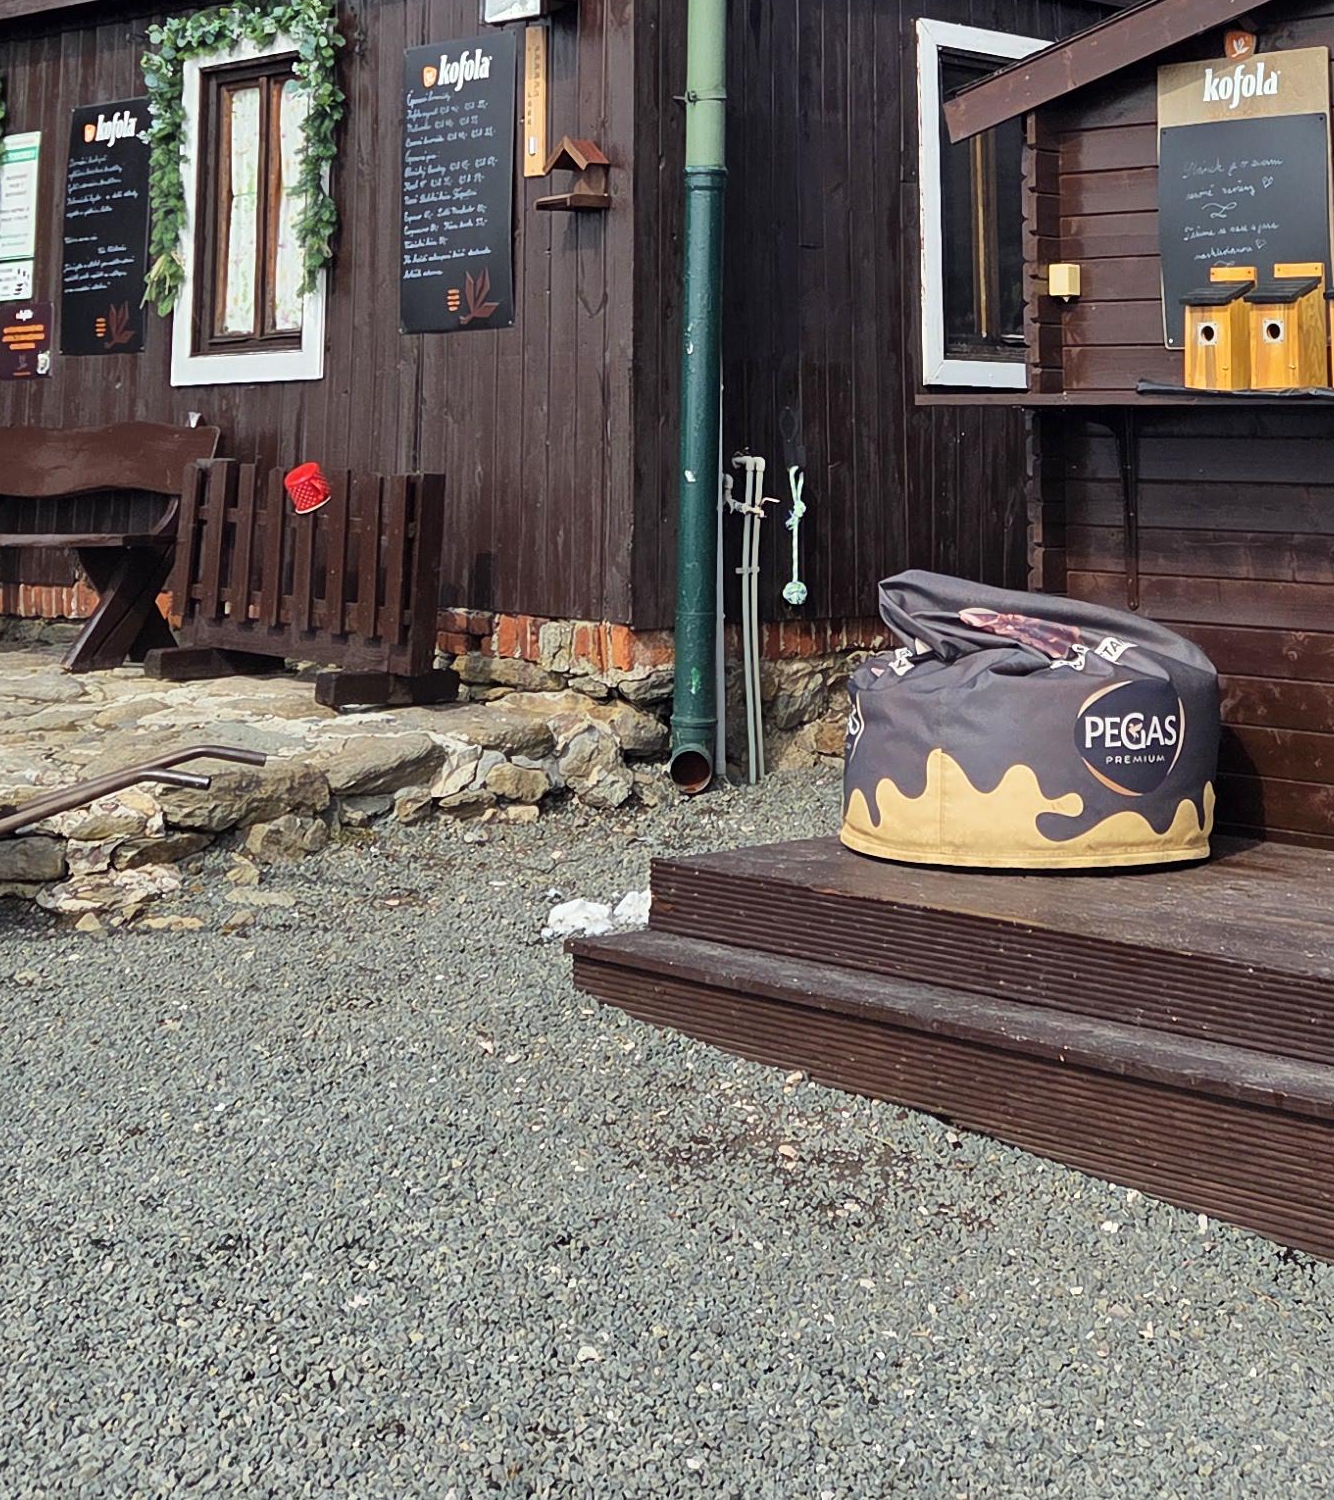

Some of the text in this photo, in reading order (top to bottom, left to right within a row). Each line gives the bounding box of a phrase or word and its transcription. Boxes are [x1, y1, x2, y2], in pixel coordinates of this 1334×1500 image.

[438, 49, 490, 92] kofola
[1203, 62, 1278, 110] kofola
[95, 111, 138, 148] kofola
[1085, 712, 1178, 751] PEGAS
[1105, 754, 1166, 765] PREMIUM
